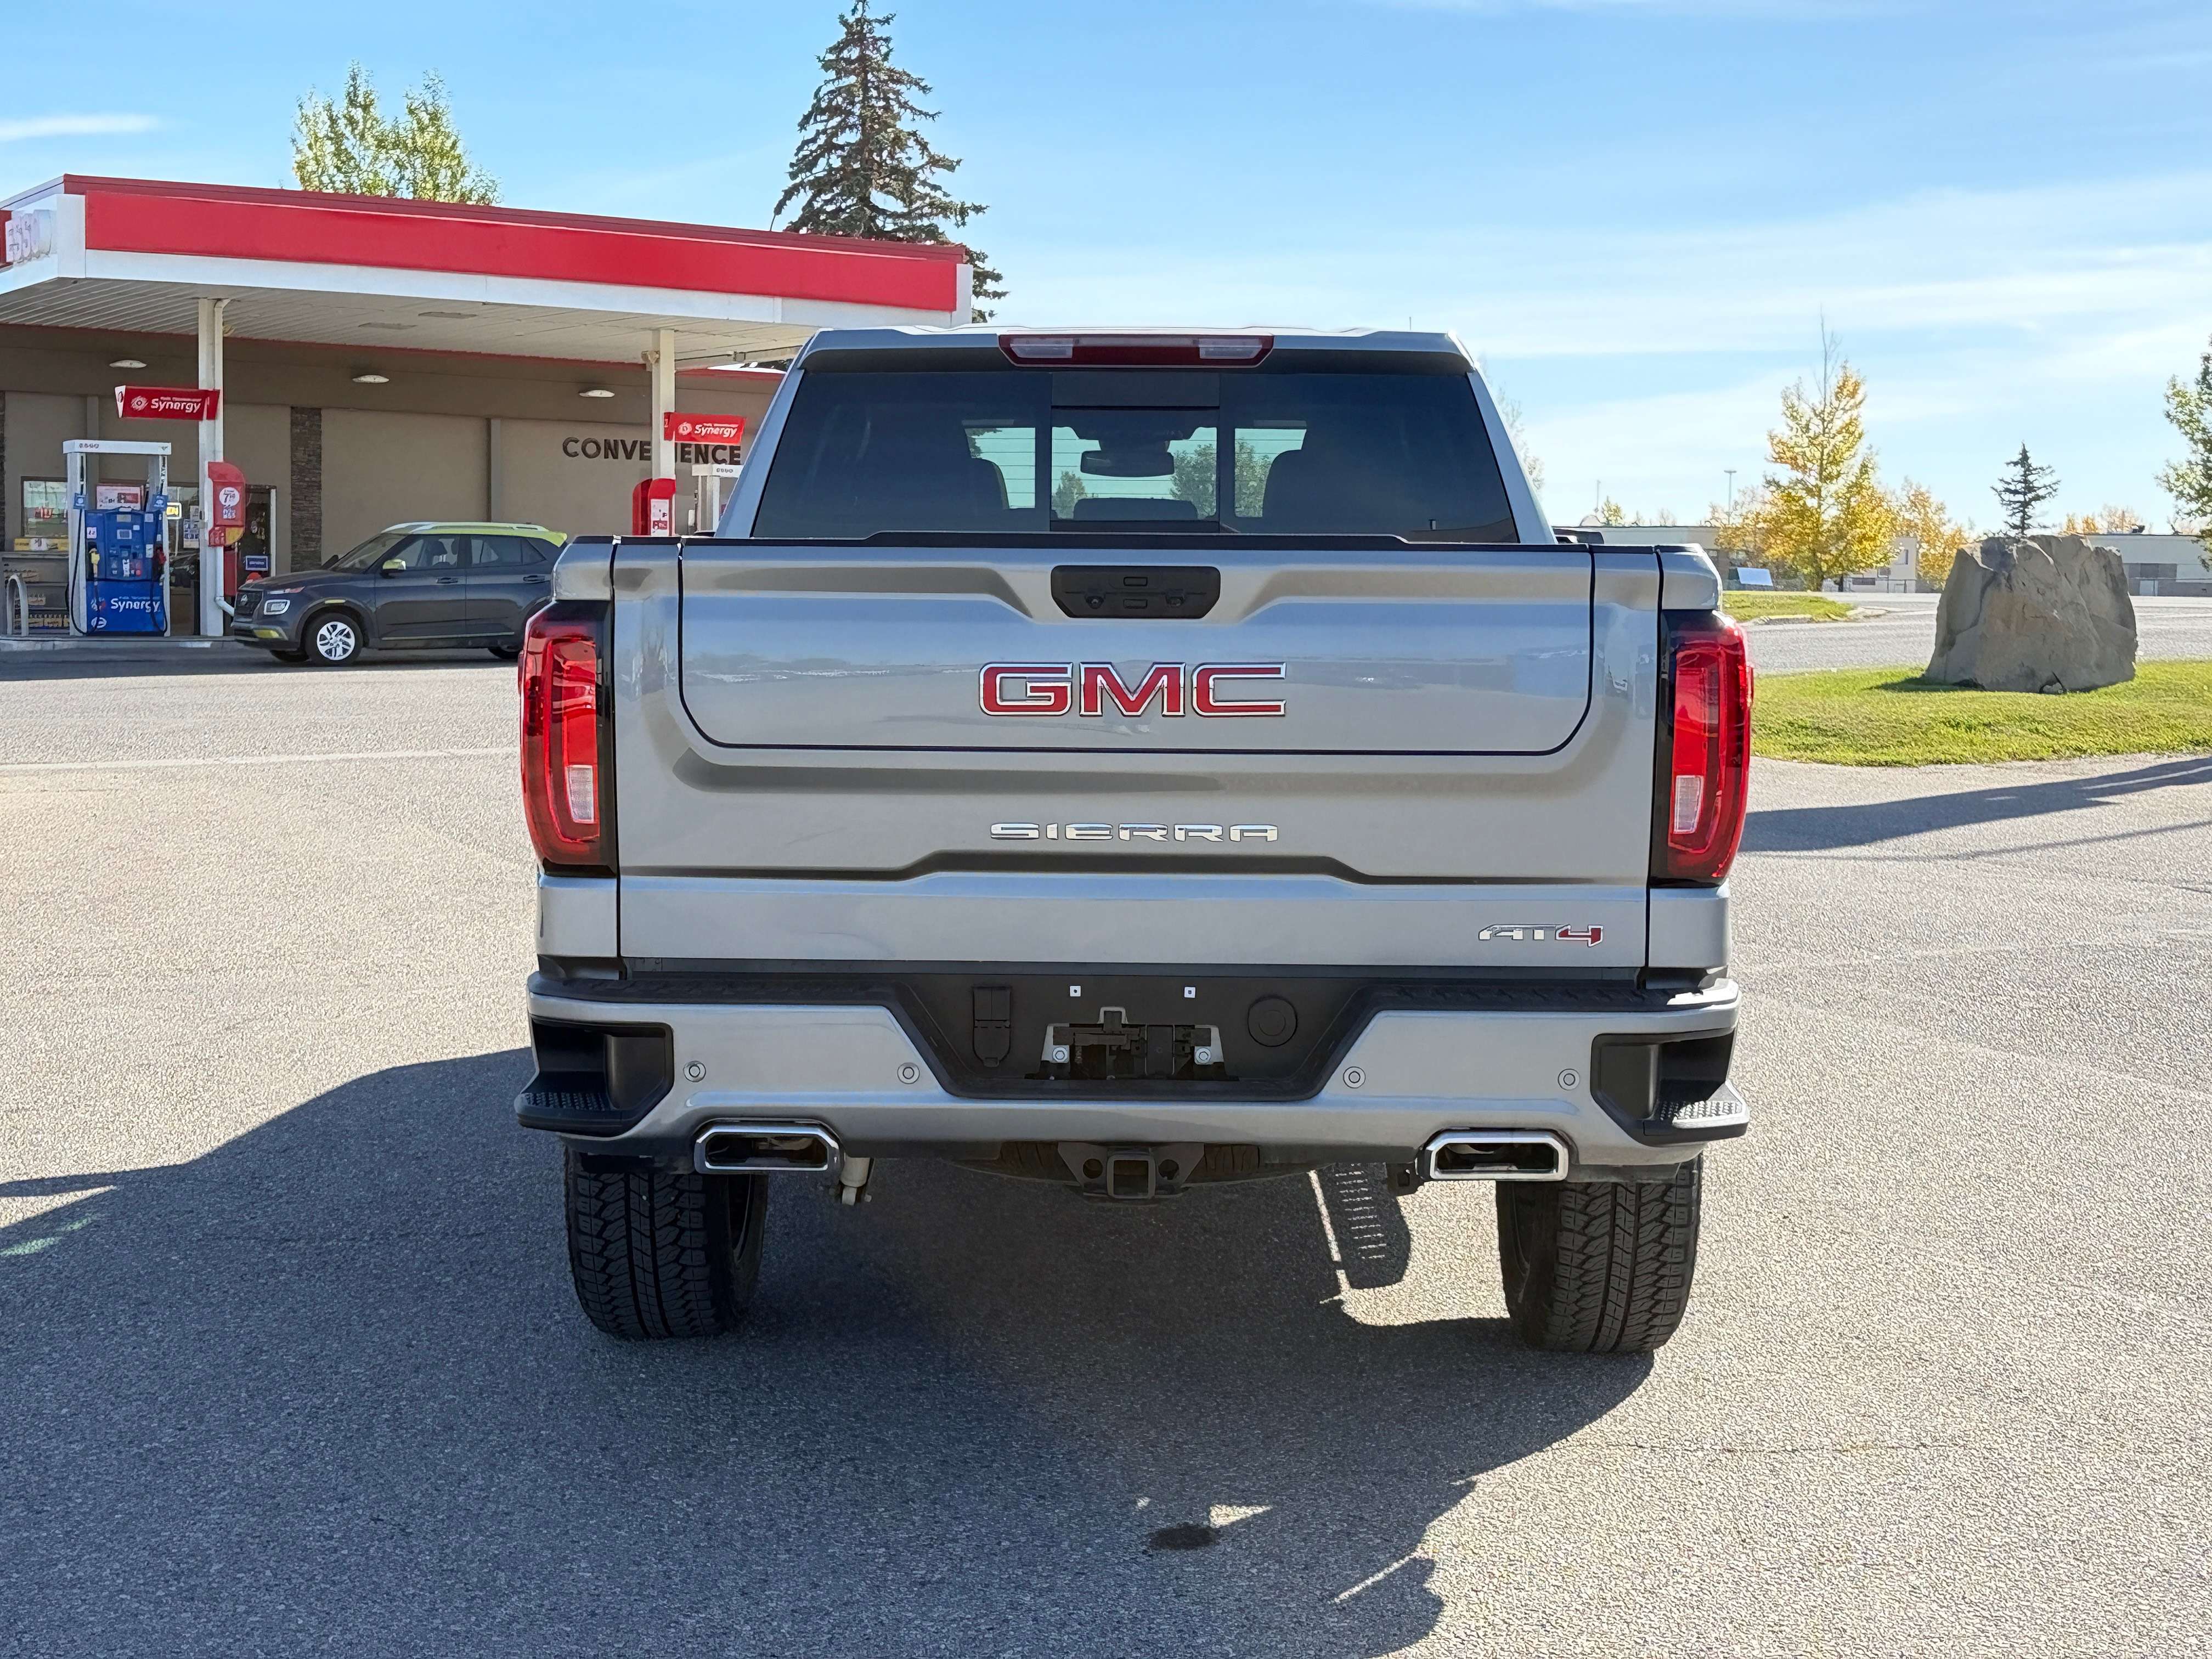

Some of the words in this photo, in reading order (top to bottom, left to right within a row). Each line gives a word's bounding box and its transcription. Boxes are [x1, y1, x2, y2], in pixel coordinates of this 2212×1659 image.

[151, 398, 201, 413] Synergy
[694, 424, 738, 437] Synergy
[562, 437, 741, 466] CONVEIENCE
[979, 662, 1286, 717] GMC
[991, 822, 1278, 842] SIERRA
[1479, 924, 1604, 947] AT4
